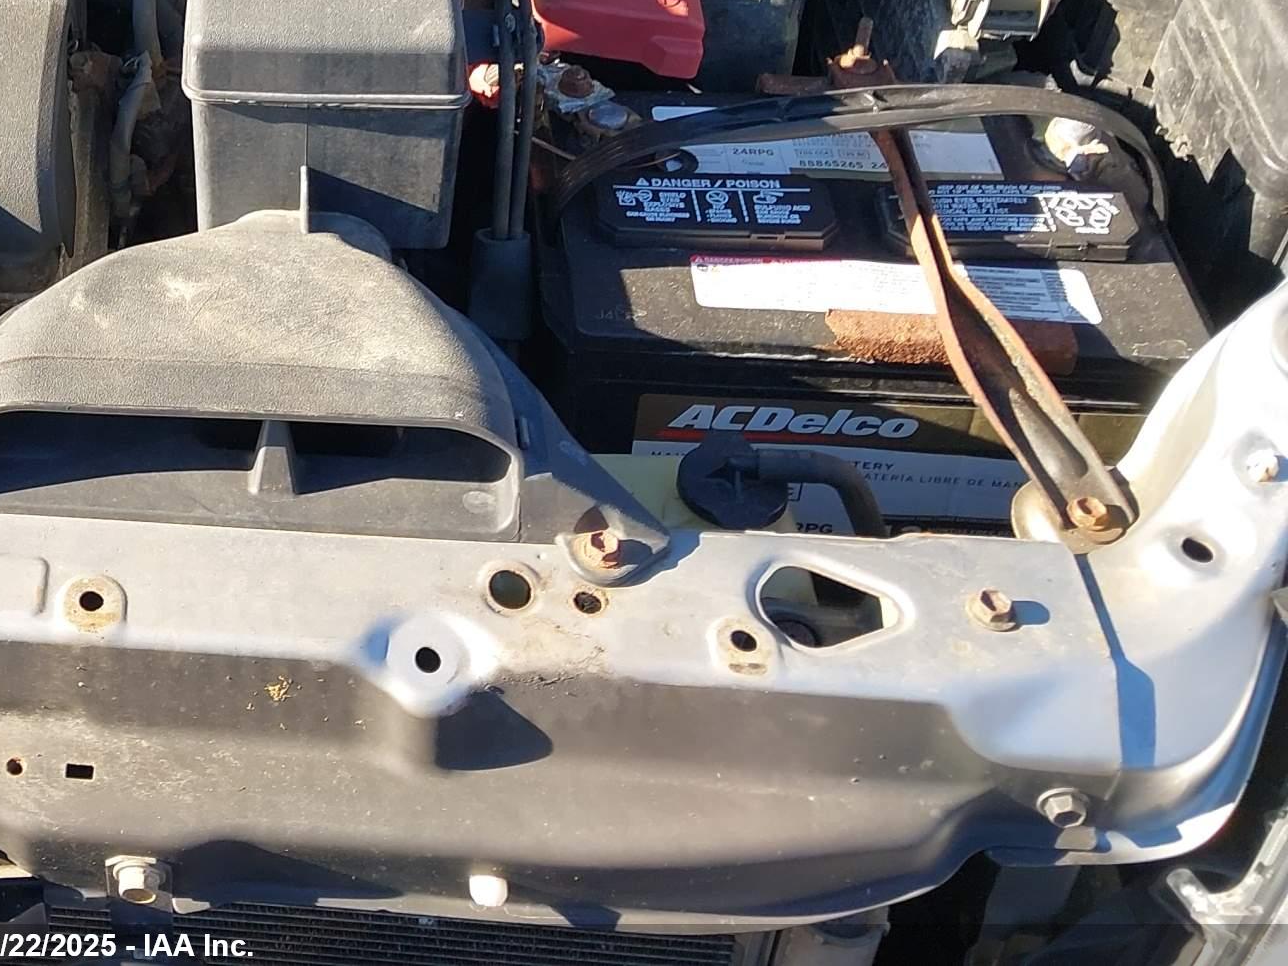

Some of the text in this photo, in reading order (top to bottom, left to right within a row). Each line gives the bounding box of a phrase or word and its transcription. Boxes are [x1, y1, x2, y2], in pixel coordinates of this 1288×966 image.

[732, 147, 774, 156] 24RPG
[651, 178, 711, 188] DANGER
[726, 179, 781, 189] POISON
[667, 404, 920, 438] ACDelco
[853, 460, 894, 471] TERY
[920, 476, 960, 484] LIBRE
[968, 479, 984, 487] DE
